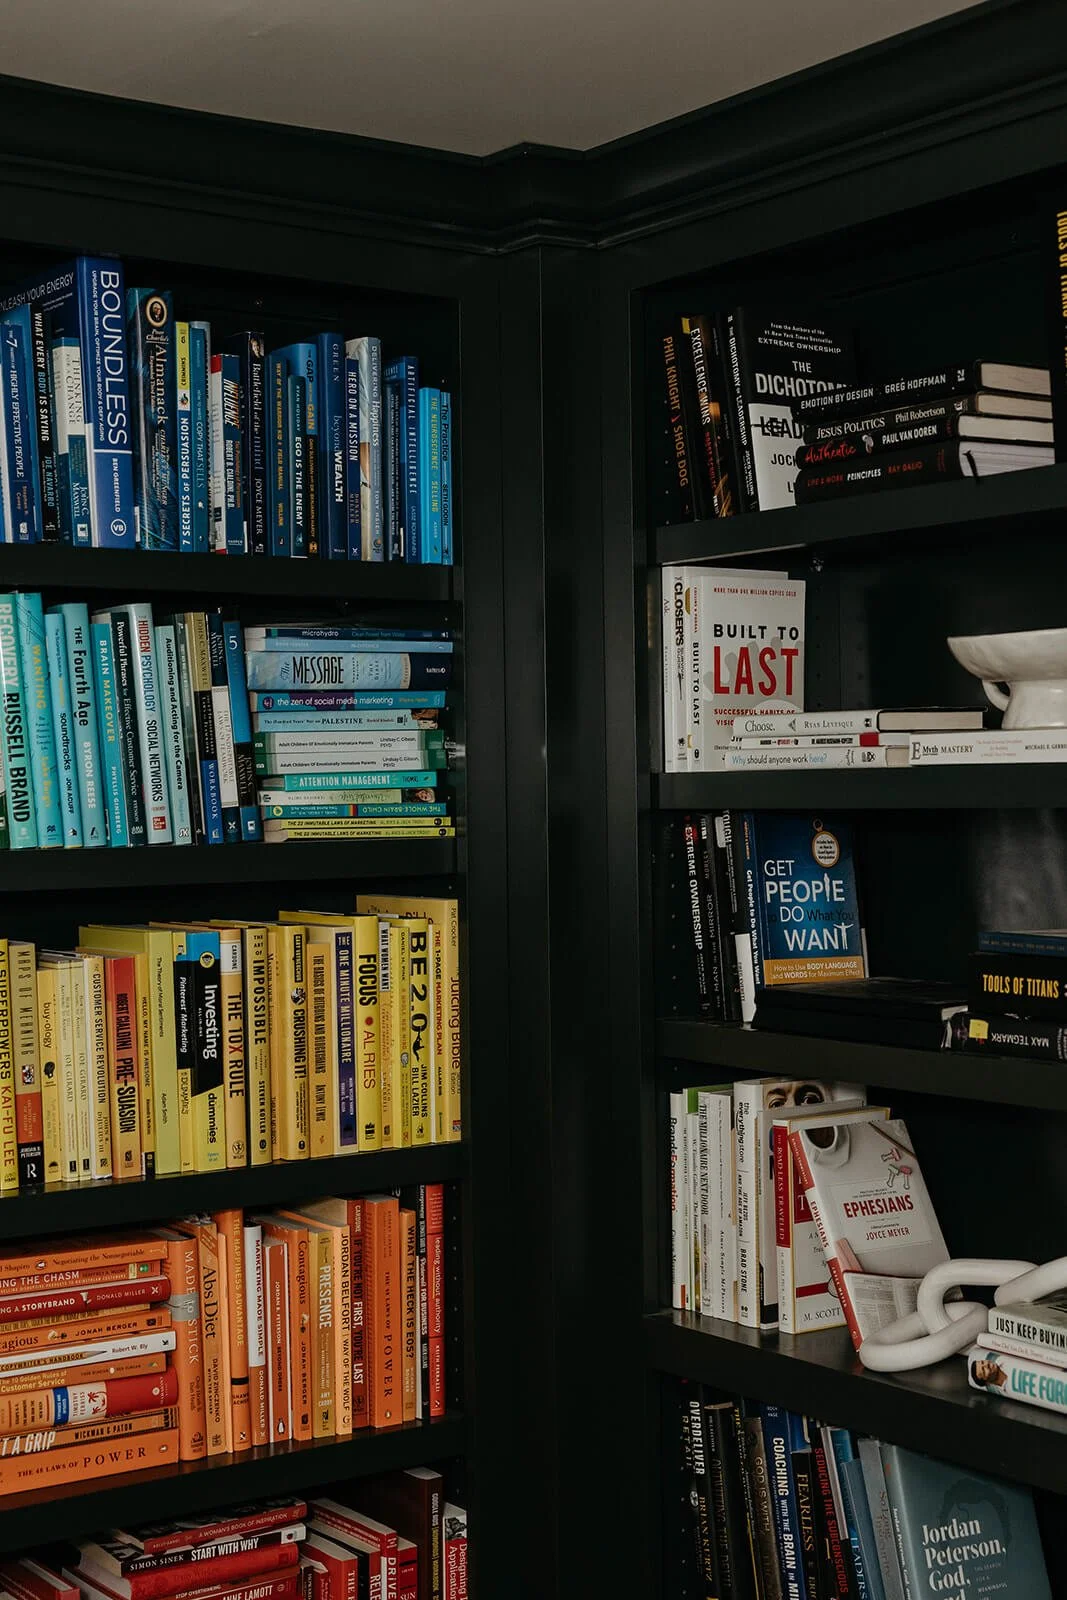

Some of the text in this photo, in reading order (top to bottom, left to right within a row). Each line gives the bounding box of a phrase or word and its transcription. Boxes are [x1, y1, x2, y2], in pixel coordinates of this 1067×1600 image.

[34, 312, 50, 441] WHAT EVERY BODY IS SAYING
[100, 270, 126, 445] BOUNDLESS
[690, 328, 711, 425] EXCELLENCE WINS
[791, 360, 812, 373] THE
[155, 345, 168, 424] Almanack
[348, 371, 356, 395] HERO
[6, 338, 24, 477] 7 HIGHLY EFFECTIVE PEOPLE
[223, 379, 240, 429] INFLUENCE
[348, 398, 357, 409] ON
[663, 336, 688, 487] PHIL KNIGHT SHOE DOG
[816, 406, 945, 439] JESUS POLITICS Phil Robertson
[196, 444, 204, 462] THAT
[349, 422, 358, 461] MISSION
[196, 463, 205, 488] SELLS
[295, 459, 302, 467] IS
[295, 470, 303, 489] THE
[254, 478, 264, 535] JOYCE MEYER
[714, 624, 799, 641] BUILT TO
[74, 627, 90, 726] THE Fourth Age
[292, 656, 344, 684] MESSAGE
[693, 679, 699, 693] TO
[714, 646, 799, 696] LAST
[99, 640, 115, 743] BRAIN MAKEOVER
[138, 620, 162, 802] HIDDEN PSYCHOLOGY SOCIAL NETWORKS
[4, 693, 30, 822] RUSSELL BRAND
[732, 753, 828, 765] Why should anyone work here?
[208, 763, 218, 820] WORKBOOK
[764, 859, 795, 876] GET
[684, 826, 703, 951] EXTREME OWNERSHIP
[780, 905, 804, 922] DO
[410, 931, 427, 1031] BE 2.0
[982, 974, 1060, 999] TOOLS OF TITANS
[227, 992, 242, 1021] THE
[253, 959, 267, 1045] IMPOSSIBLE
[358, 954, 377, 1089] FOCUS AL RIES
[92, 974, 106, 1104] CUSTOMER SERVICE REVOLUTION
[228, 1028, 243, 1054] 10X
[293, 1008, 306, 1063] CRUSHING
[991, 1032, 1049, 1048] MAX TEGMARK
[115, 993, 136, 1133] ROBERT CIALDINI PRE-SUASION
[202, 984, 219, 1144] Investing dummies
[230, 1060, 244, 1098] RULE
[294, 1065, 306, 1079] IT!
[412, 1086, 420, 1116] LAZIER
[699, 1104, 709, 1215] THE MILLIONAIRE NEXT DOOR
[843, 1195, 914, 1219] EPHESIANS
[866, 1227, 911, 1241] JOYCE MEYER
[341, 1234, 349, 1278] JORDAN
[20, 1274, 40, 1284] THE
[44, 1271, 80, 1282] CHASM
[319, 1265, 332, 1329] PRESENCE
[406, 1225, 415, 1358] WHAT THE HECK IS EOS?
[14, 1305, 20, 1313] A
[22, 1298, 75, 1311] STORYBRAND
[184, 1250, 199, 1364] MADE to STICK
[203, 1266, 219, 1338] Abs Diet
[341, 1281, 350, 1331] BELFORT
[996, 1318, 1014, 1334] JUST
[1017, 1323, 1037, 1340] KEEP
[342, 1355, 349, 1368] OF
[1011, 1368, 1037, 1397] LIFE
[12, 1431, 56, 1454] A GRIP
[690, 1401, 705, 1475] OVERDELIVER
[772, 1437, 789, 1496] COACHING
[783, 1533, 796, 1569] BRAIN
[796, 1473, 815, 1552] FEARLESS
[815, 1447, 849, 1593] SEDUCING THE SUBCONSCIOUS
[922, 1518, 981, 1546] Jordan
[129, 1538, 259, 1572] SIMON SINEK START WITH WHY
[925, 1539, 1007, 1569] Peterson,
[929, 1565, 971, 1591] God,
